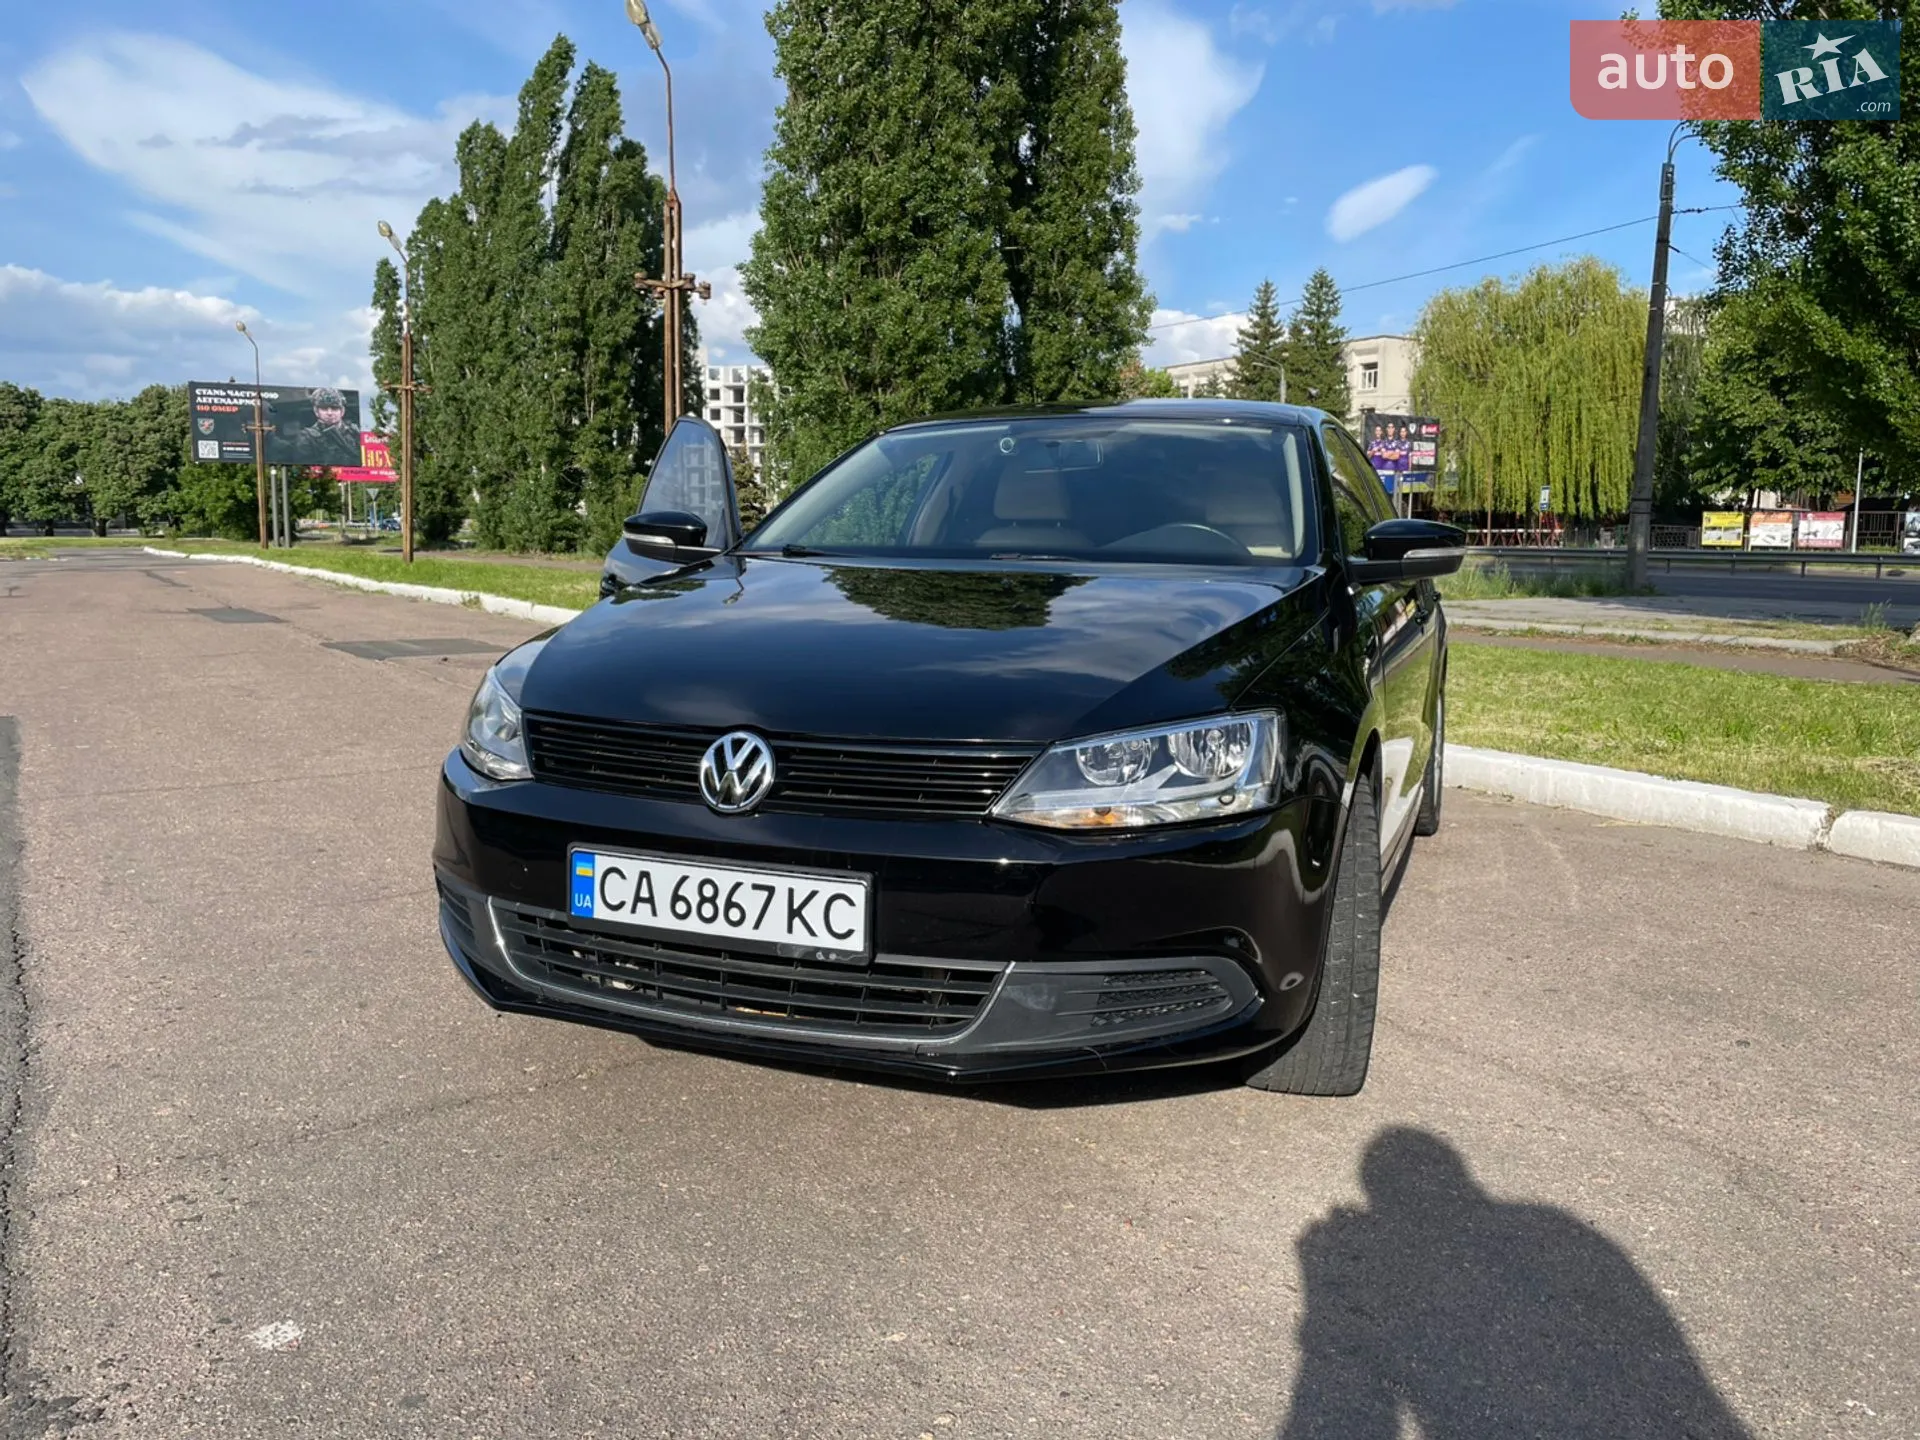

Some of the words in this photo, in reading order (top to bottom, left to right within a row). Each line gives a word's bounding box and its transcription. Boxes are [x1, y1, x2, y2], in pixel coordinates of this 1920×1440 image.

[574, 892, 593, 910] UA
[599, 866, 658, 918] CA
[669, 874, 776, 931] 6867
[786, 886, 857, 941] KC
